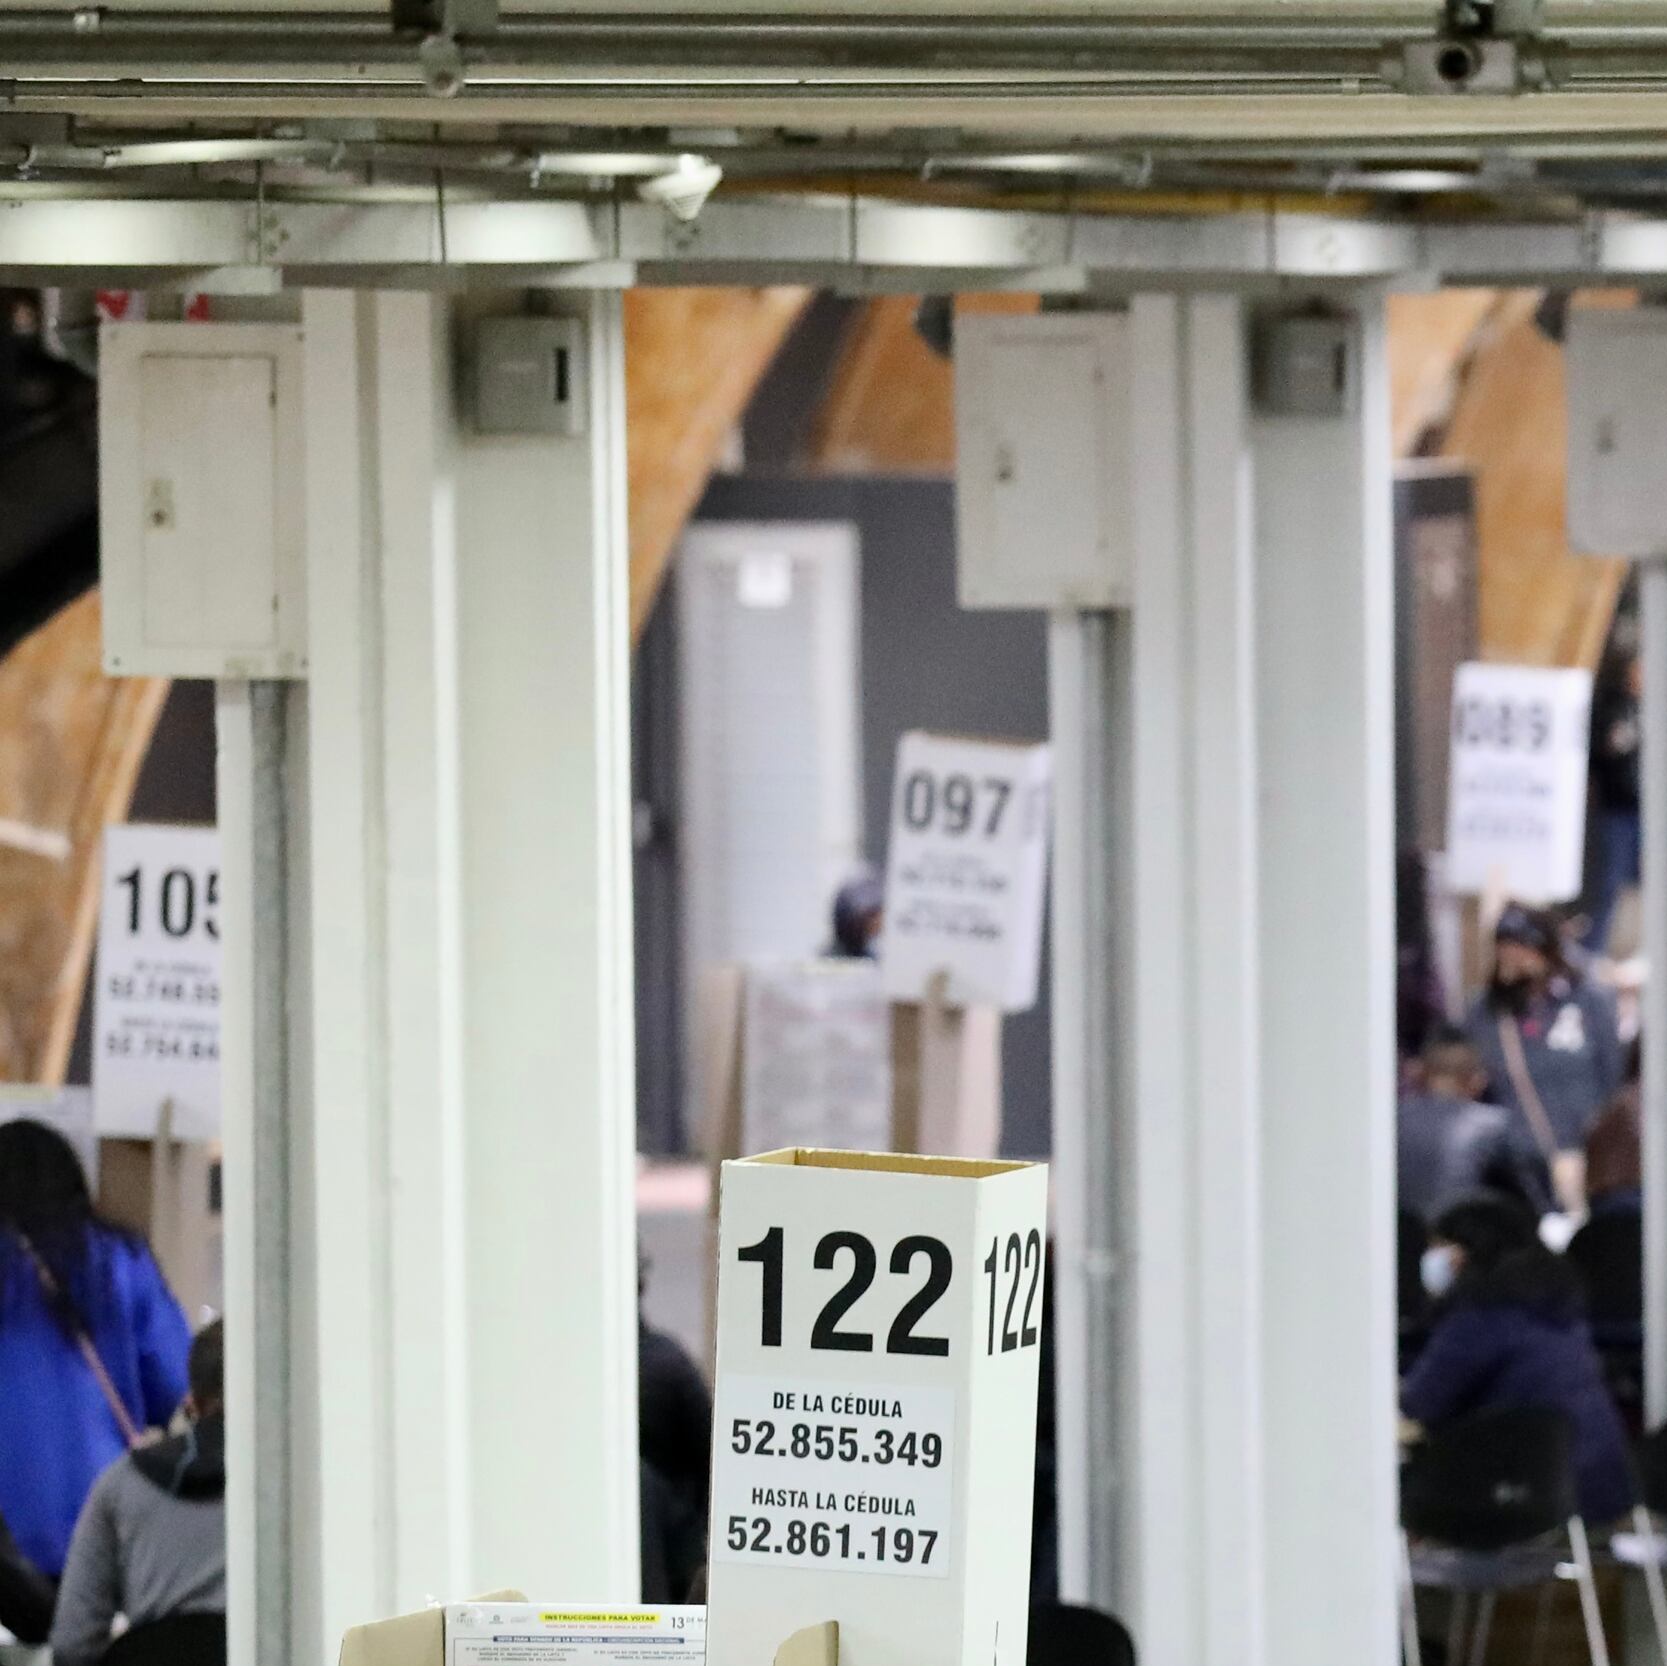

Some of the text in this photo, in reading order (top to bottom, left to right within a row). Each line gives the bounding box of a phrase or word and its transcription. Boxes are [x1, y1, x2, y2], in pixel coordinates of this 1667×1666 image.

[904, 768, 1012, 837] 097
[737, 1226, 953, 1357] 122
[984, 1227, 1041, 1356] 122
[772, 1391, 903, 1419] DE LA CÉDULA
[731, 1420, 943, 1468] 52.855.349
[751, 1487, 916, 1517] HASTA LA CÉDULA
[727, 1516, 939, 1565] 52.861.197
[672, 1617, 685, 1629] 13
